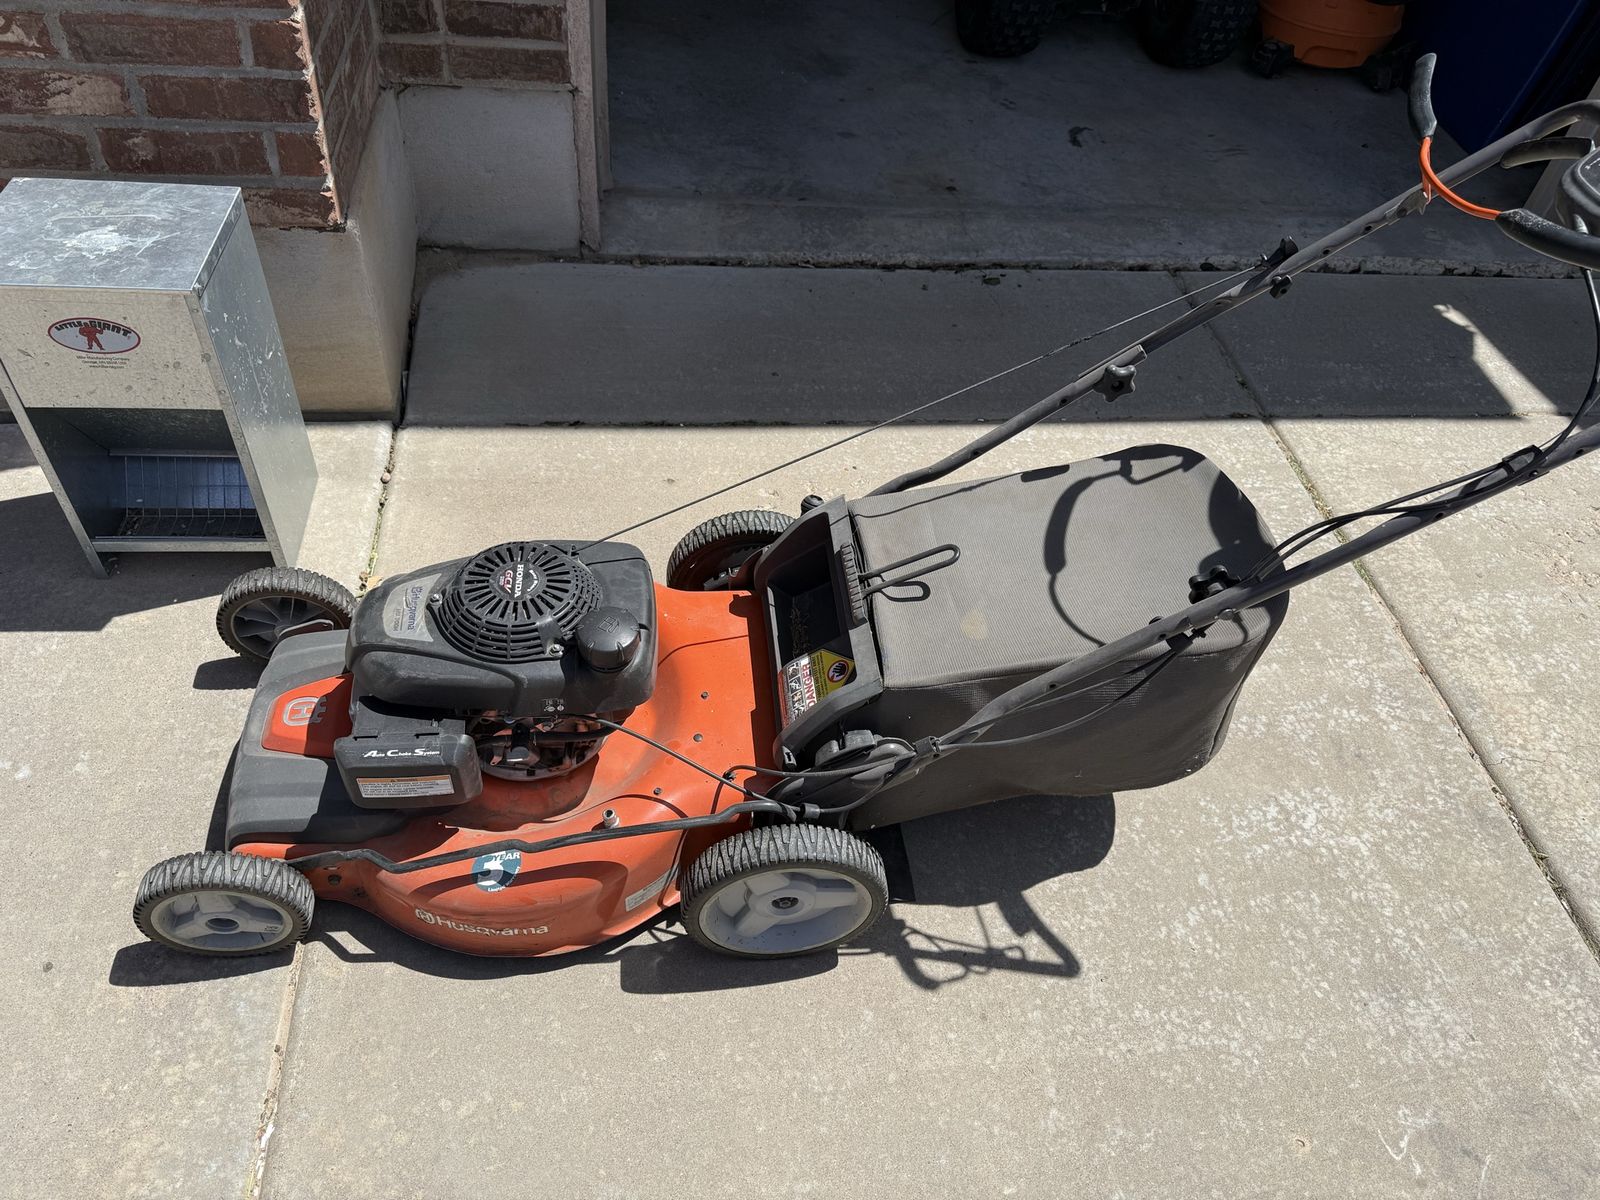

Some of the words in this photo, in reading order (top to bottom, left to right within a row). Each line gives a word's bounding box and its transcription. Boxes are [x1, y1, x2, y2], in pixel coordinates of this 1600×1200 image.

[55, 321, 83, 331] LITTLE
[89, 321, 131, 336] GIANT
[503, 569, 513, 594] GCV
[514, 563, 524, 598] HONDA
[408, 594, 420, 631] Husqvarna
[802, 664, 816, 706] DANGER
[387, 749, 411, 757] Choke
[414, 748, 441, 757] System
[493, 852, 521, 861] YEAR
[436, 915, 549, 936] Husqvarna
